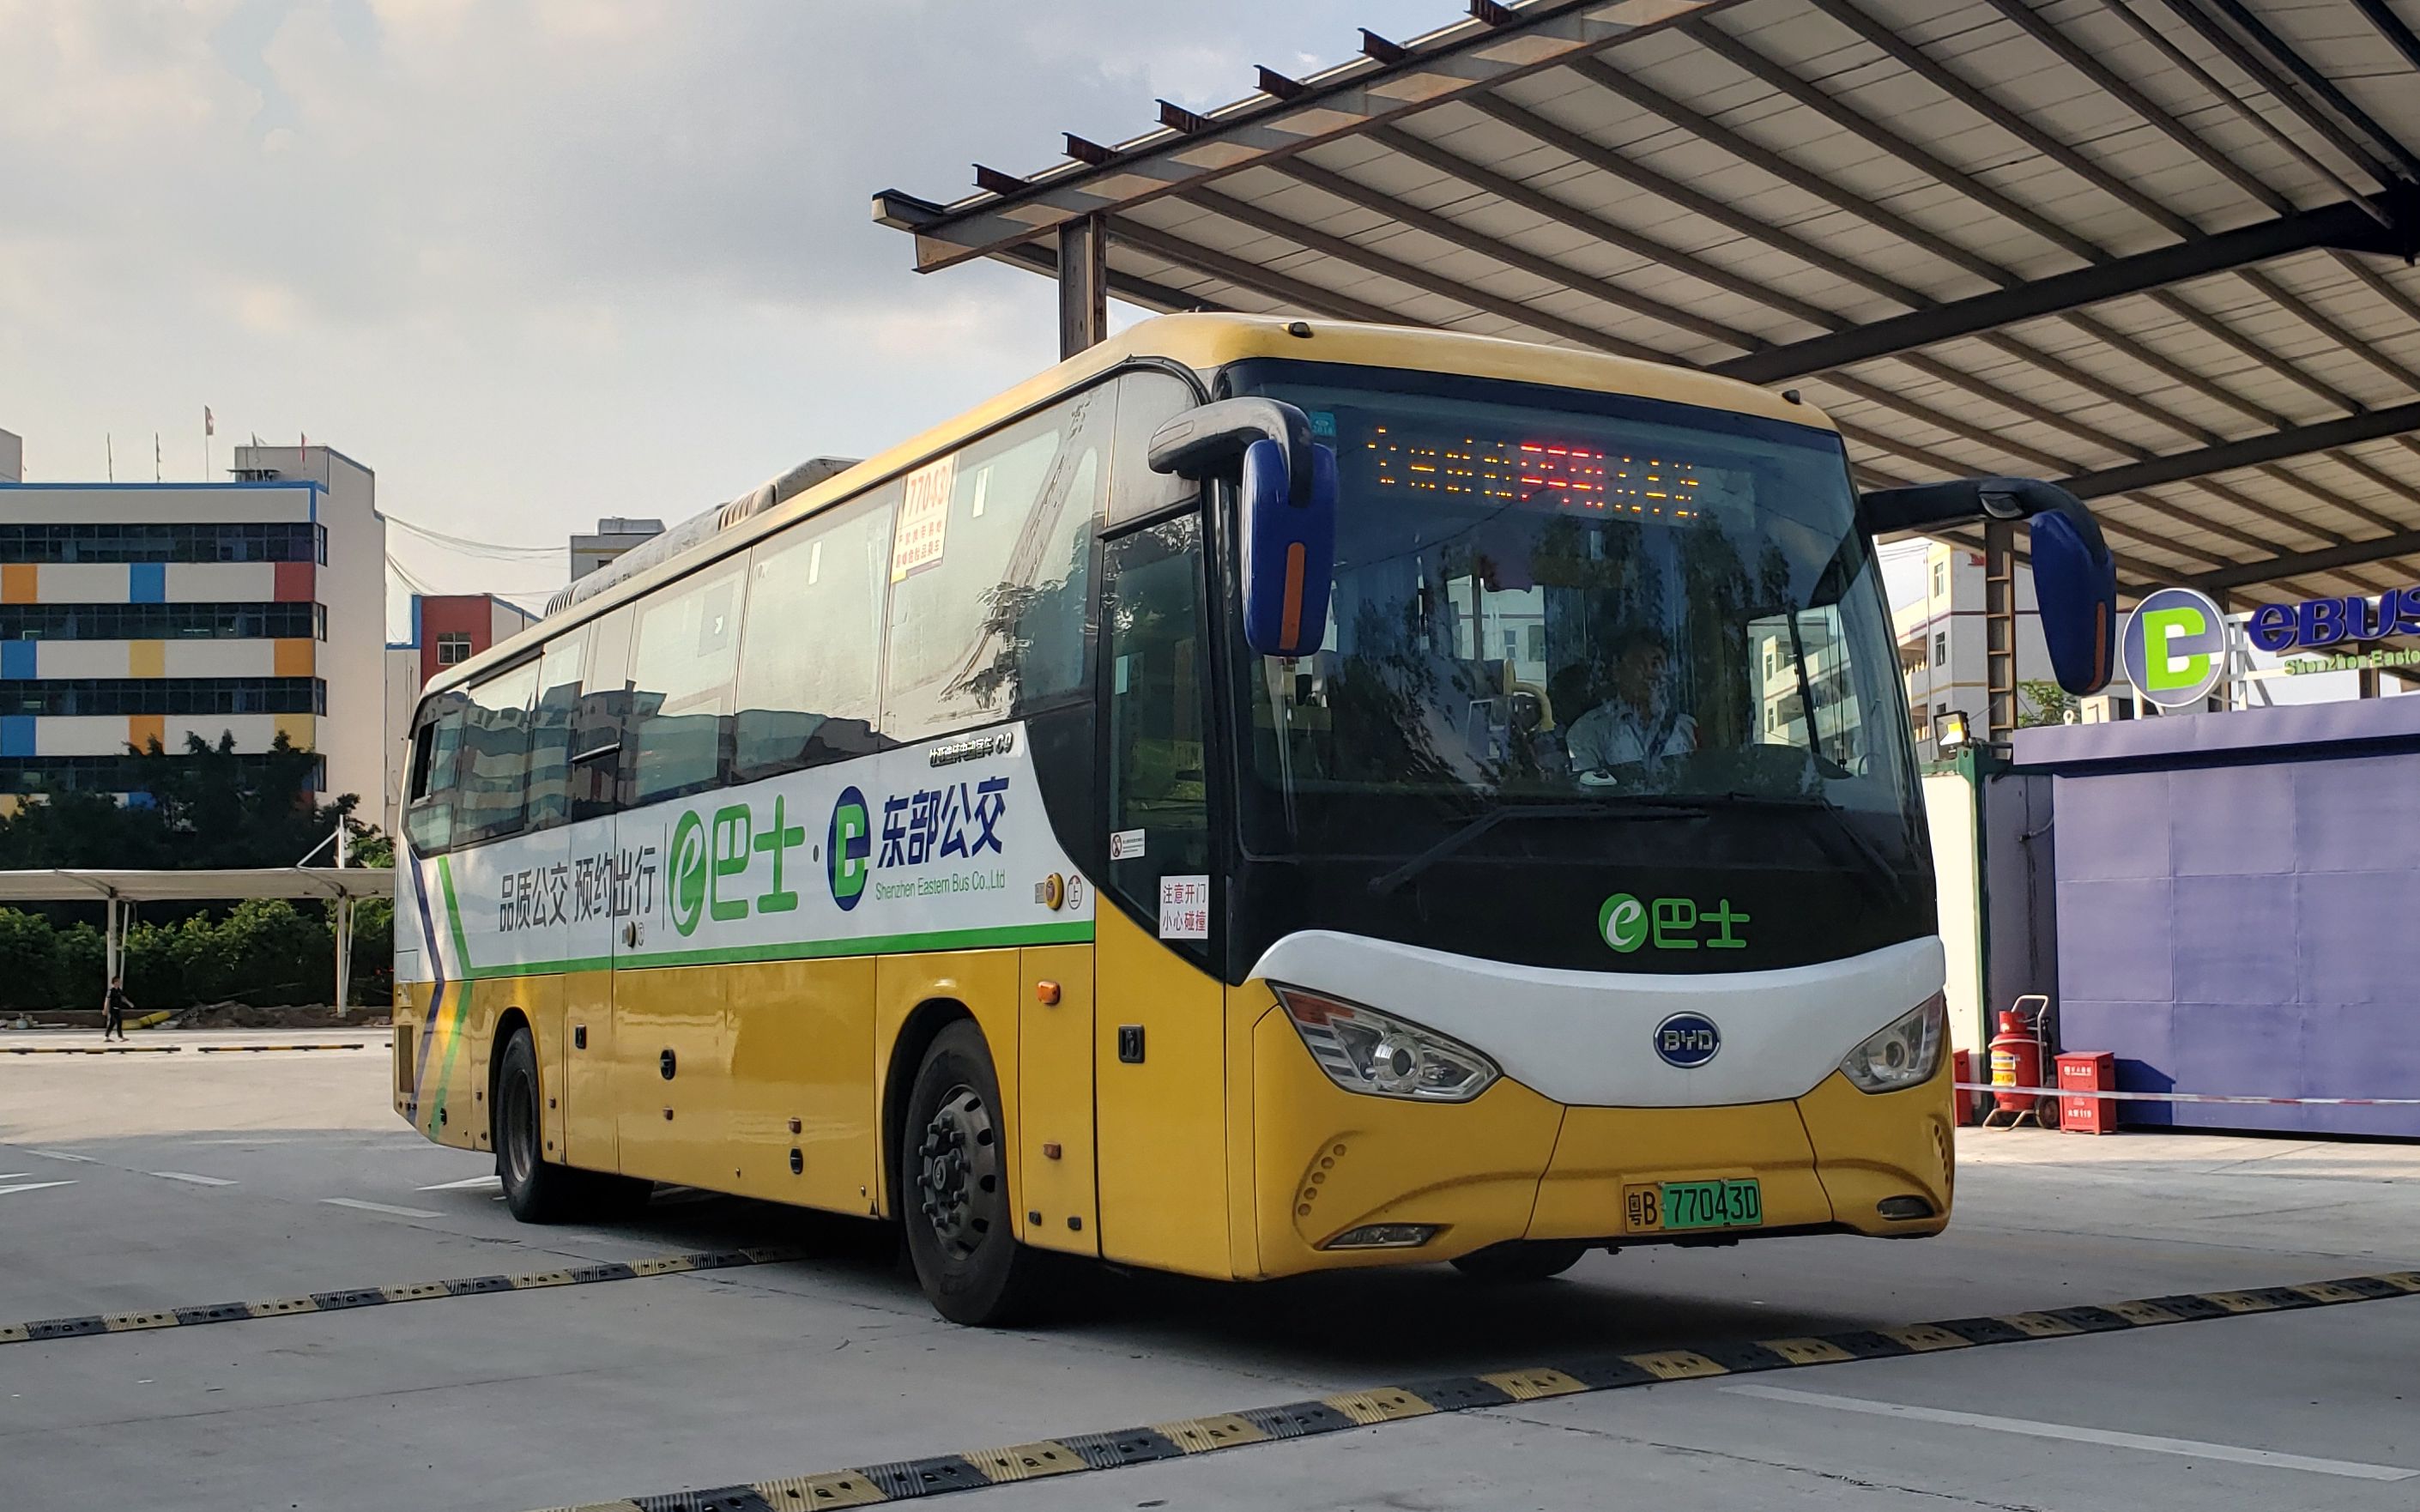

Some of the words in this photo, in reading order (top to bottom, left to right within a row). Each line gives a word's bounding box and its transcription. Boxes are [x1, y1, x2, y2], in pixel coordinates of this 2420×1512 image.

[499, 862, 568, 932] 品质公交
[574, 845, 656, 923] 预约出行
[877, 776, 1010, 869] 东部公交
[875, 880, 916, 900] Shenzhen
[917, 877, 950, 896] Eastern
[953, 874, 970, 892] Bus
[1163, 882, 1207, 904] 注意开门
[1162, 910, 1207, 932] 小心碰撞
[1661, 1029, 1715, 1052] BYD
